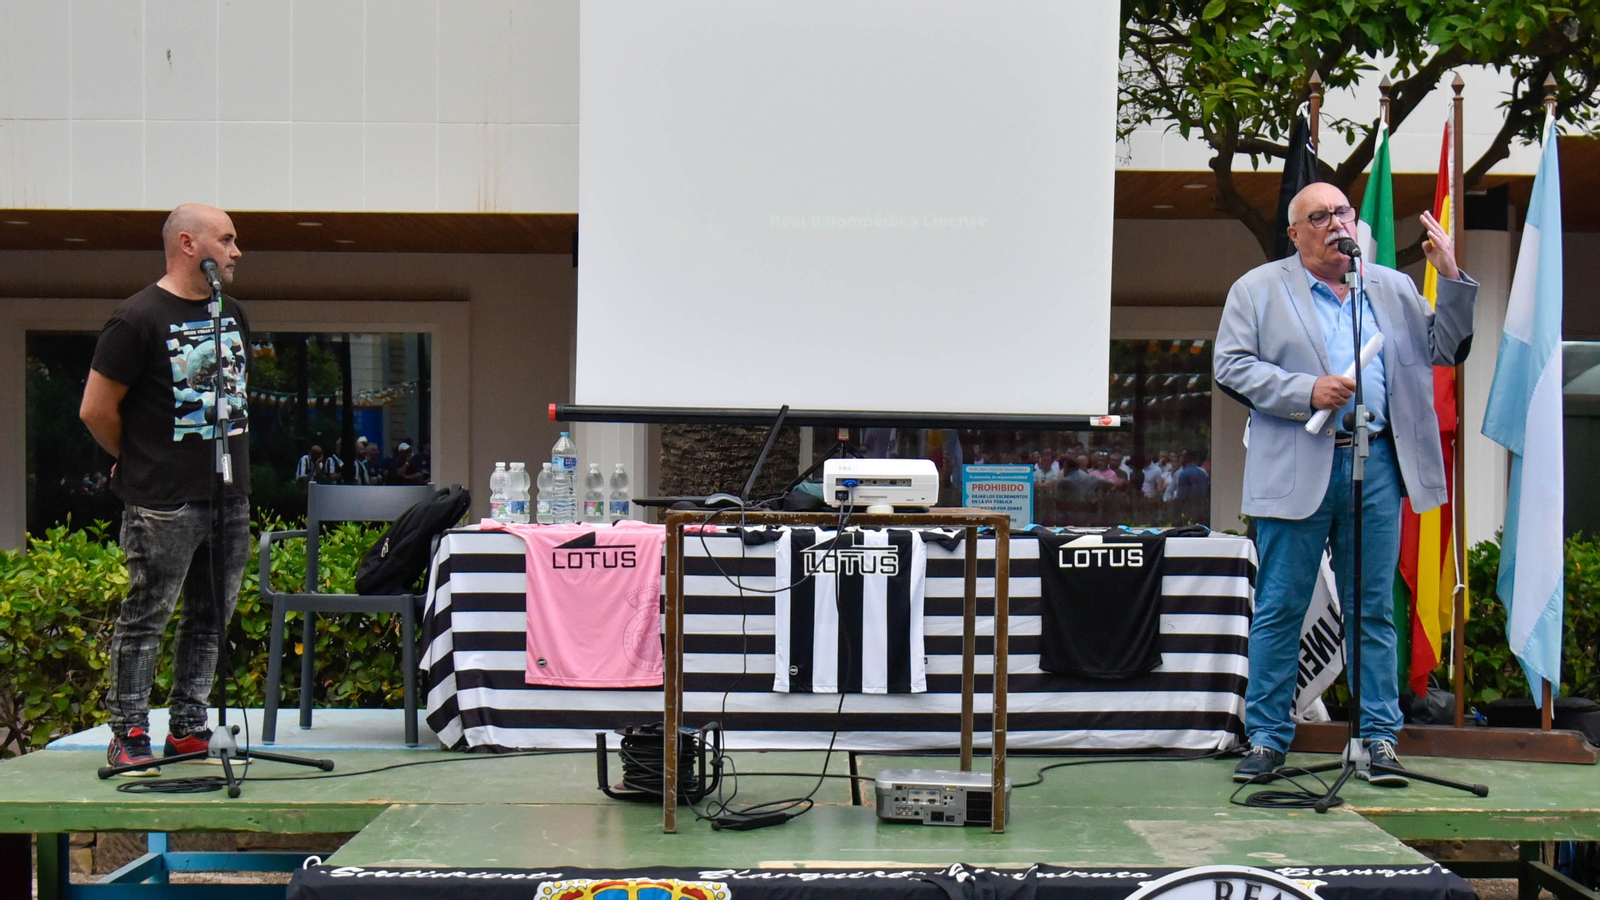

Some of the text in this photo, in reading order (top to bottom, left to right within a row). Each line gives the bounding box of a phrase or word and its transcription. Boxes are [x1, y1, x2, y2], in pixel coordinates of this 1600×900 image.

[769, 214, 806, 228] Real
[923, 213, 988, 228] Linense
[972, 483, 1024, 491] PROHIBIDO
[552, 551, 636, 569] LOTUS
[804, 553, 899, 576] LOTUS
[1058, 548, 1144, 568] LOTUS
